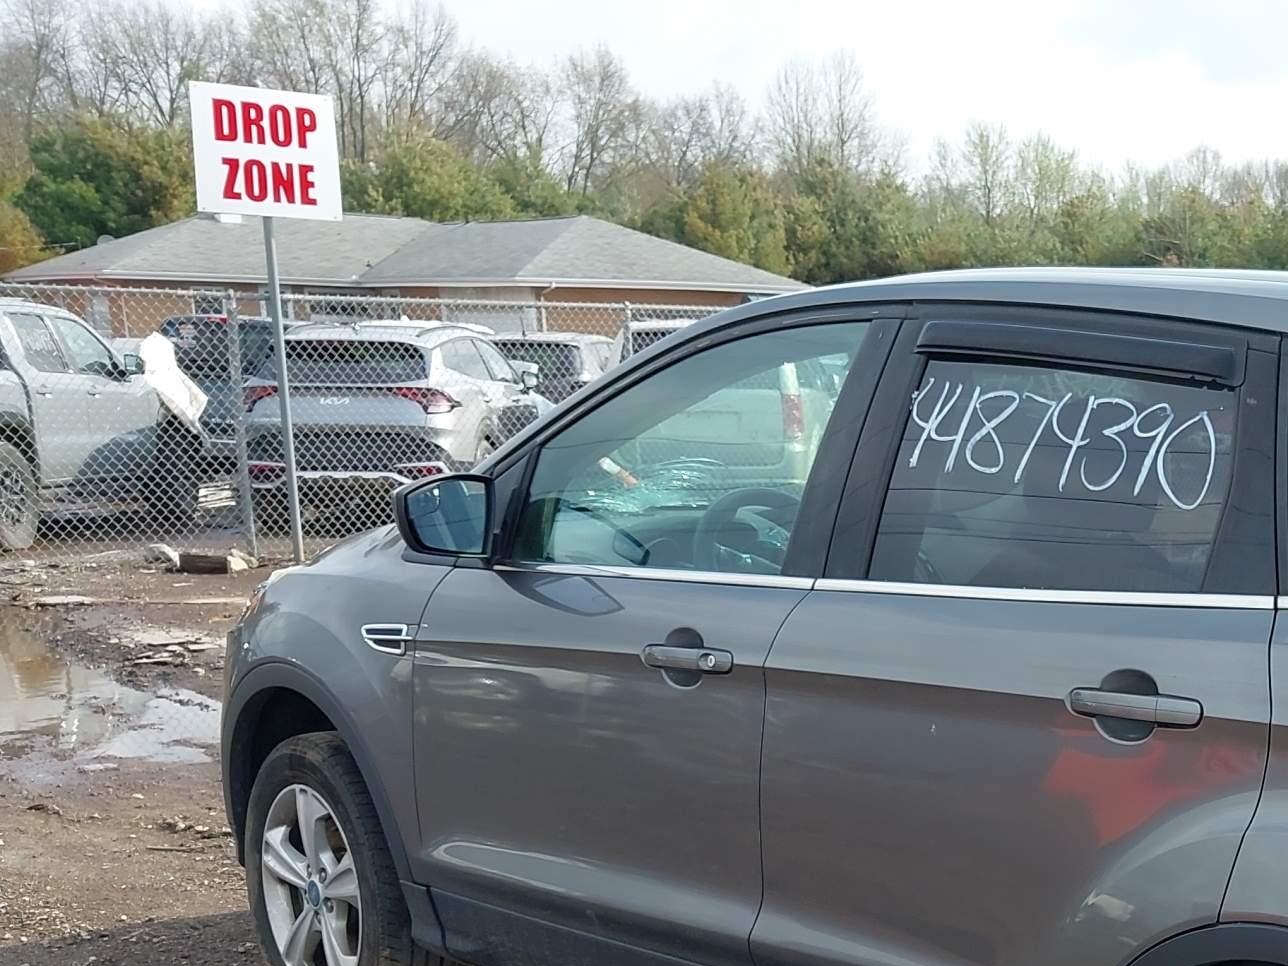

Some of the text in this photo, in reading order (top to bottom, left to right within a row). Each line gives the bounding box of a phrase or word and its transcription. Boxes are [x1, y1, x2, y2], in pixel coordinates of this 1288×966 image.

[211, 98, 317, 149] DROP
[221, 156, 318, 206] ZONE
[909, 377, 1216, 510] 44874390
